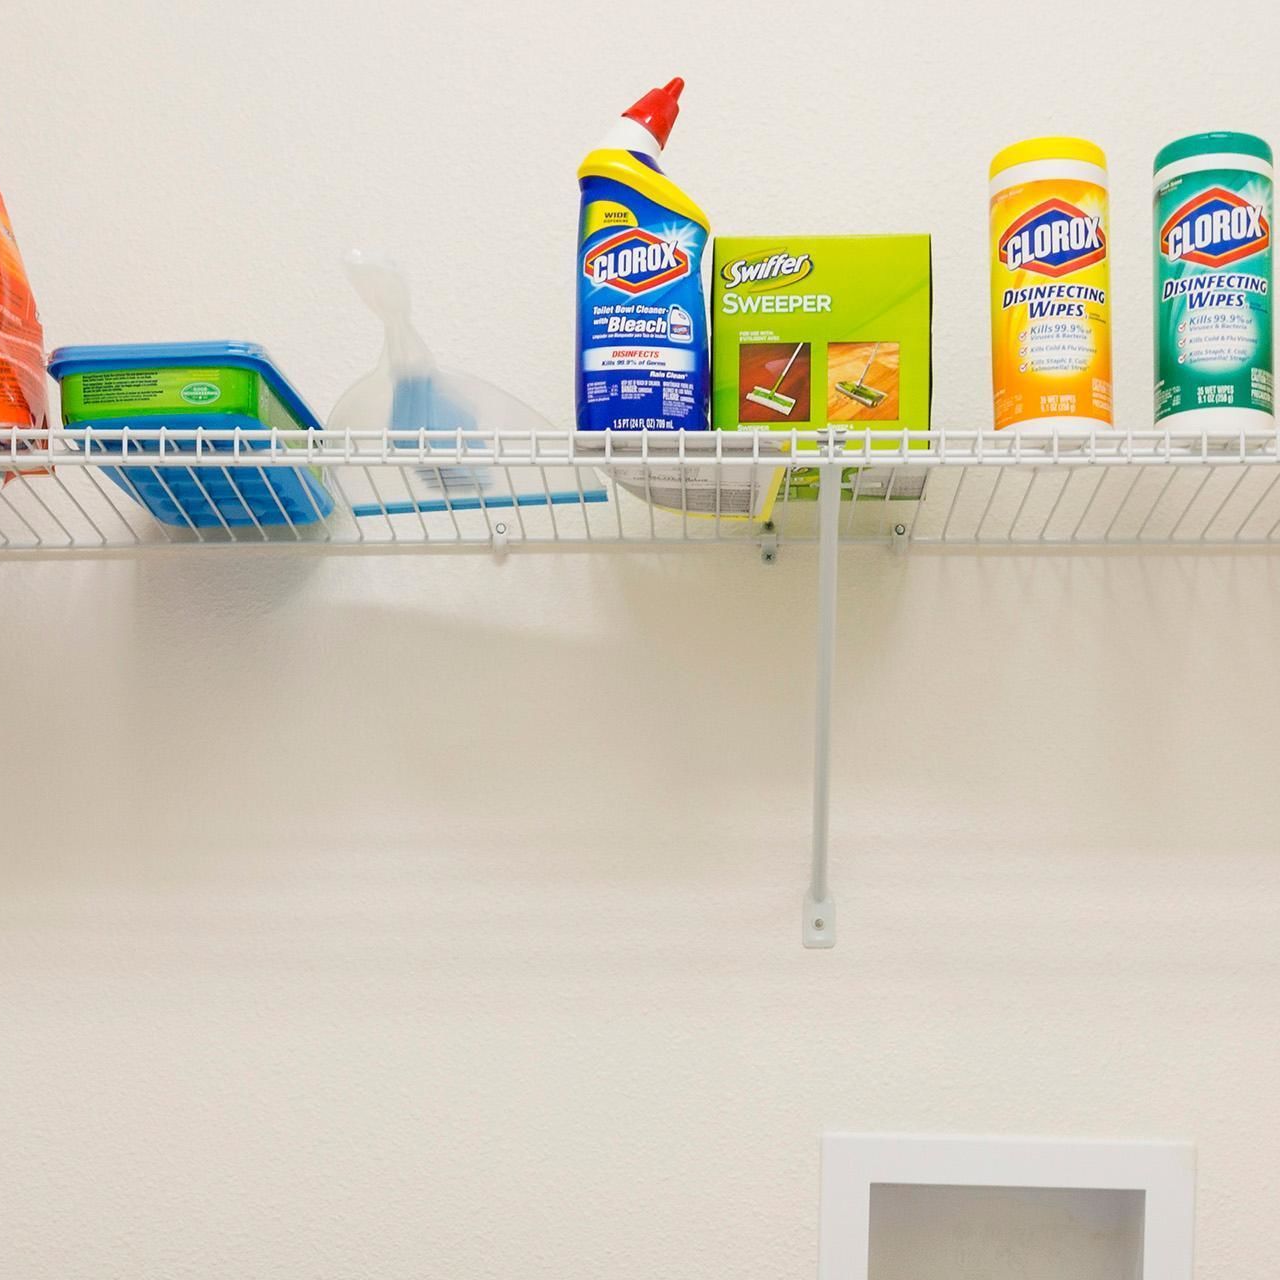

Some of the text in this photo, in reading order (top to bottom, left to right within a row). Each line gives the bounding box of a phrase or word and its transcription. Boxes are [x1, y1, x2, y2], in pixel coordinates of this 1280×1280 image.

[604, 211, 629, 219] WIDE
[1168, 205, 1263, 261] CLOROX
[1006, 217, 1099, 271] CLOROX
[592, 240, 678, 284] CLOROX
[725, 253, 809, 289] Swiffer
[1163, 275, 1267, 300] DISINFECTING
[723, 293, 832, 315] SWEEPER
[1003, 285, 1105, 309] DISINFECTING
[1188, 291, 1245, 309] WIPES
[593, 306, 613, 315] Toilet
[615, 304, 634, 314] Bowl
[1029, 300, 1084, 319] WIPES
[593, 316, 666, 333] with Bleach
[1189, 314, 1245, 326] Kills 99.9%
[1030, 324, 1084, 335] Kills 99.9%
[611, 350, 660, 359] DISINFECTS
[613, 419, 621, 428] 1.5
[622, 419, 629, 428] PT
